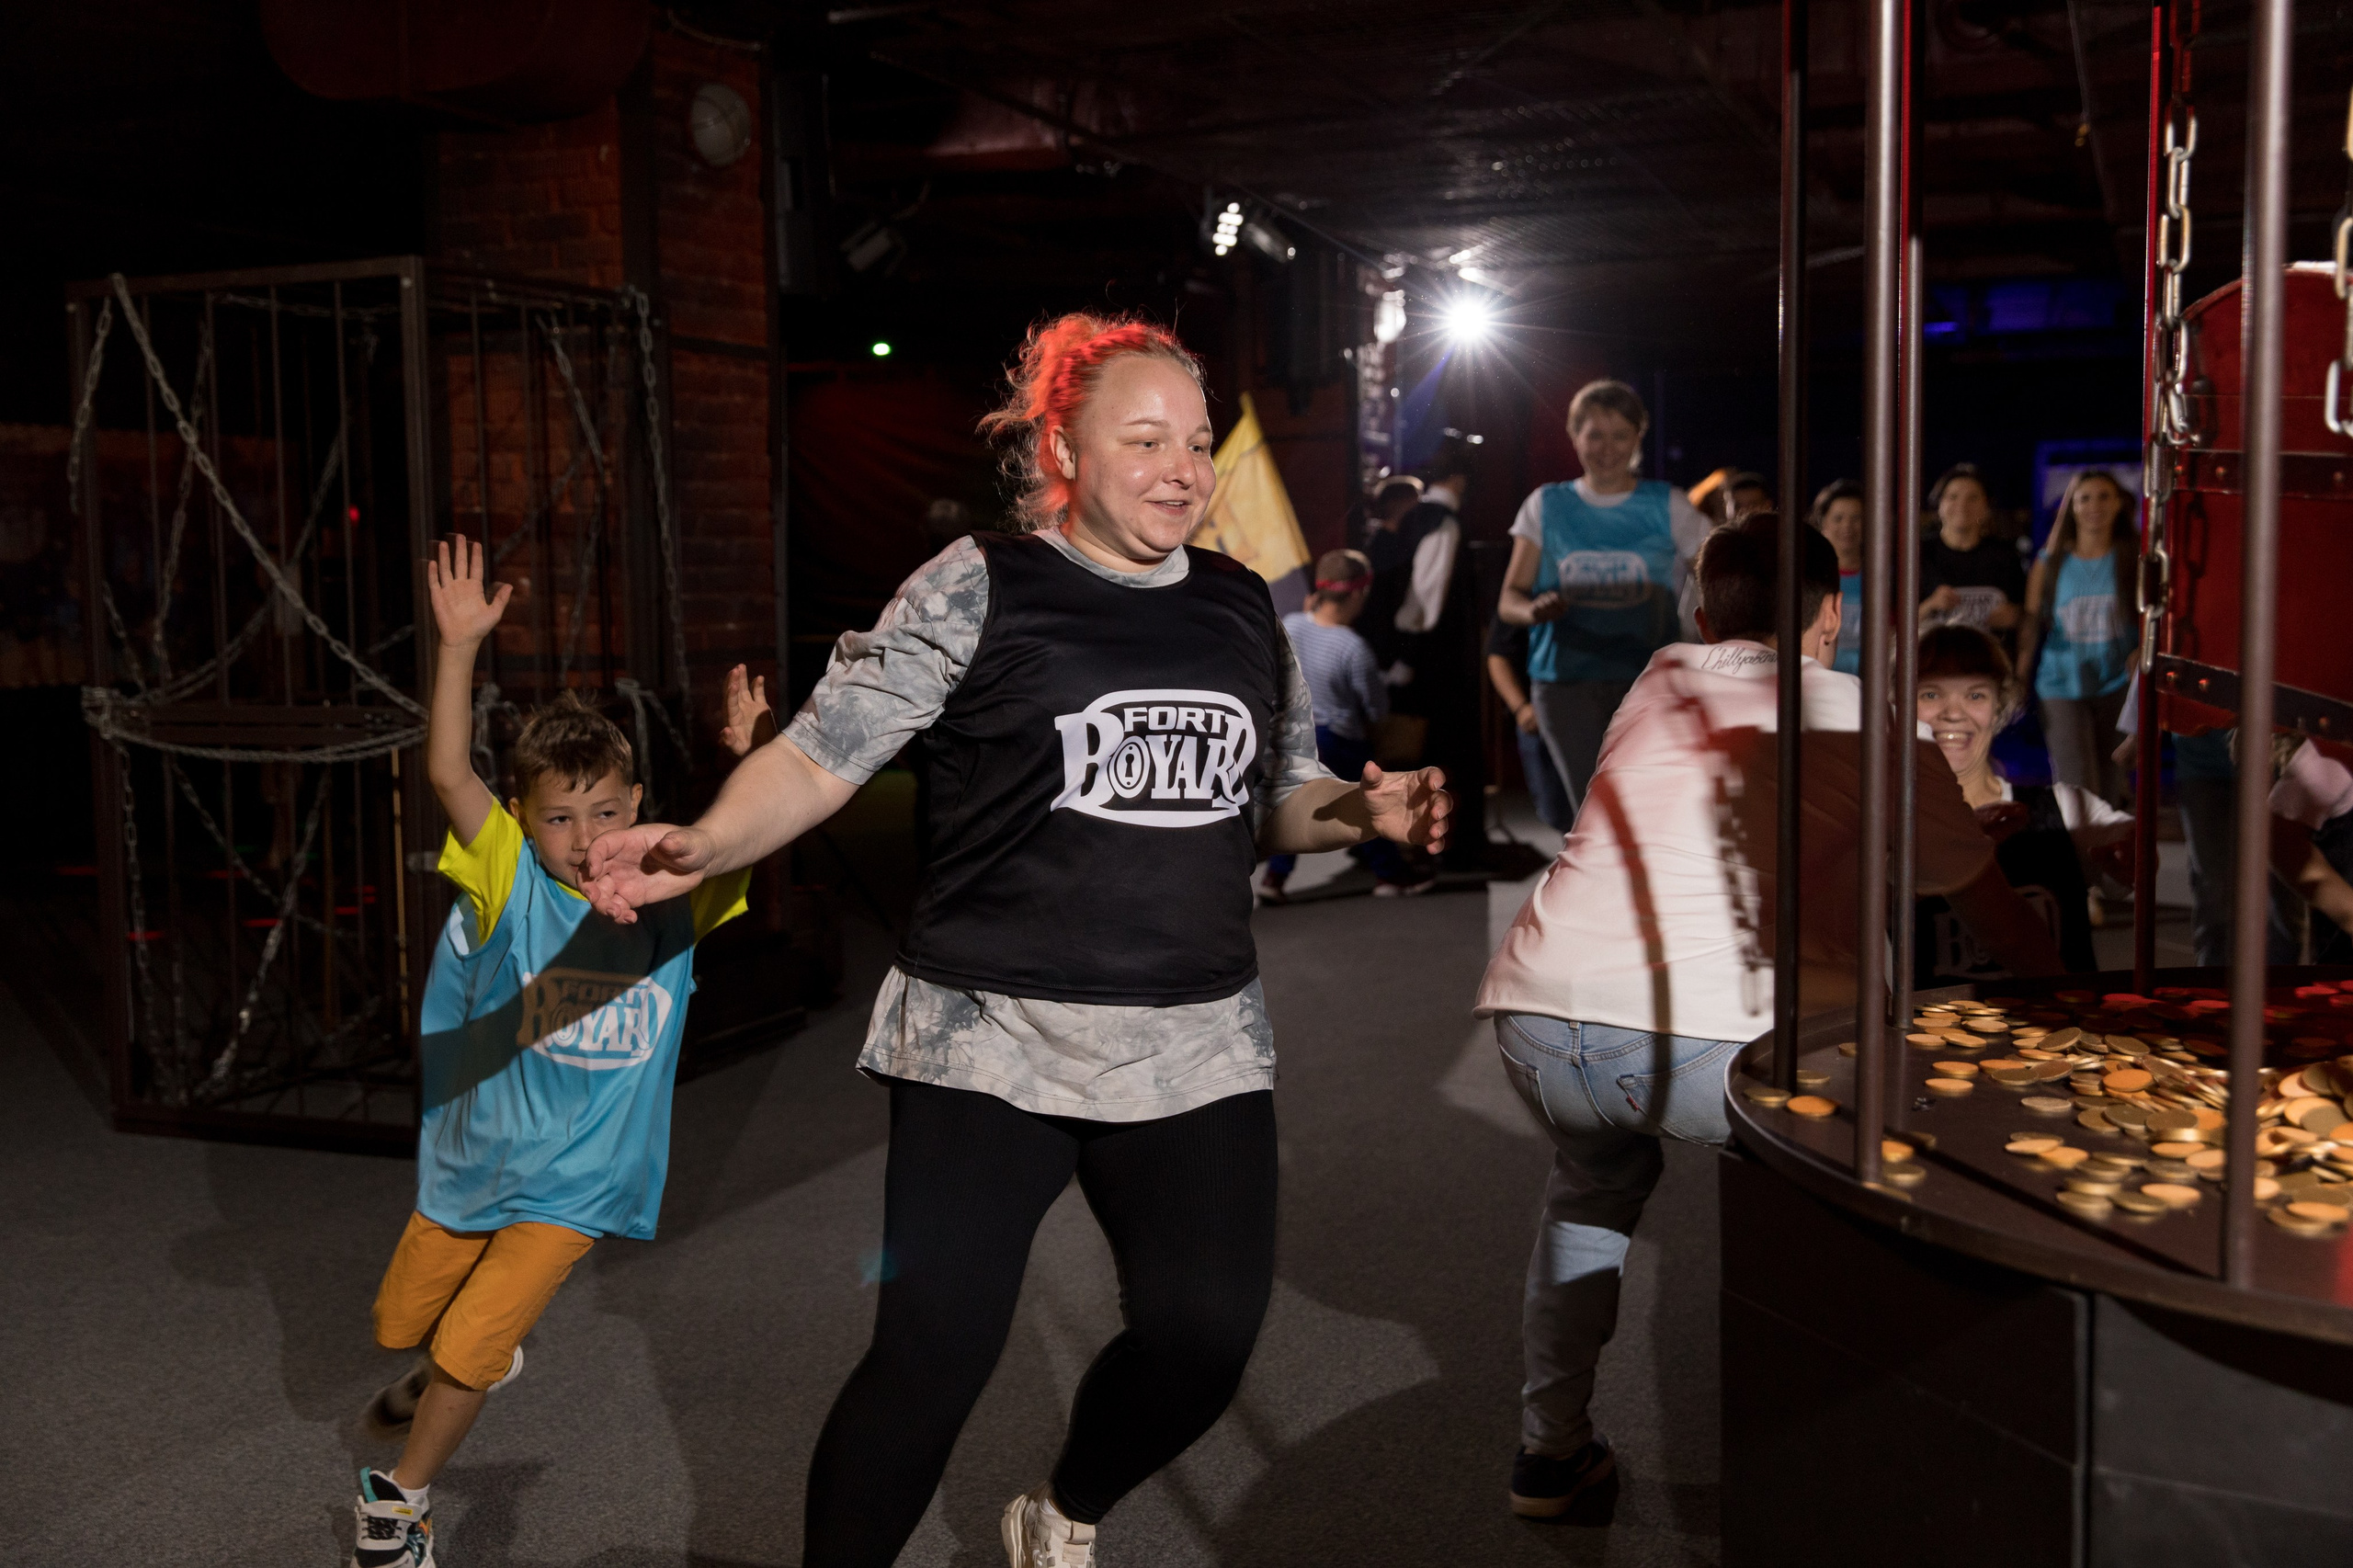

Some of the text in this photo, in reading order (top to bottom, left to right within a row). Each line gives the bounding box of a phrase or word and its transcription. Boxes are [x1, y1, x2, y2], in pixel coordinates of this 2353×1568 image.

[1051, 711, 1257, 816] BOYARD
[1123, 706, 1226, 734] FORT
[516, 971, 673, 1058] BOYARD
